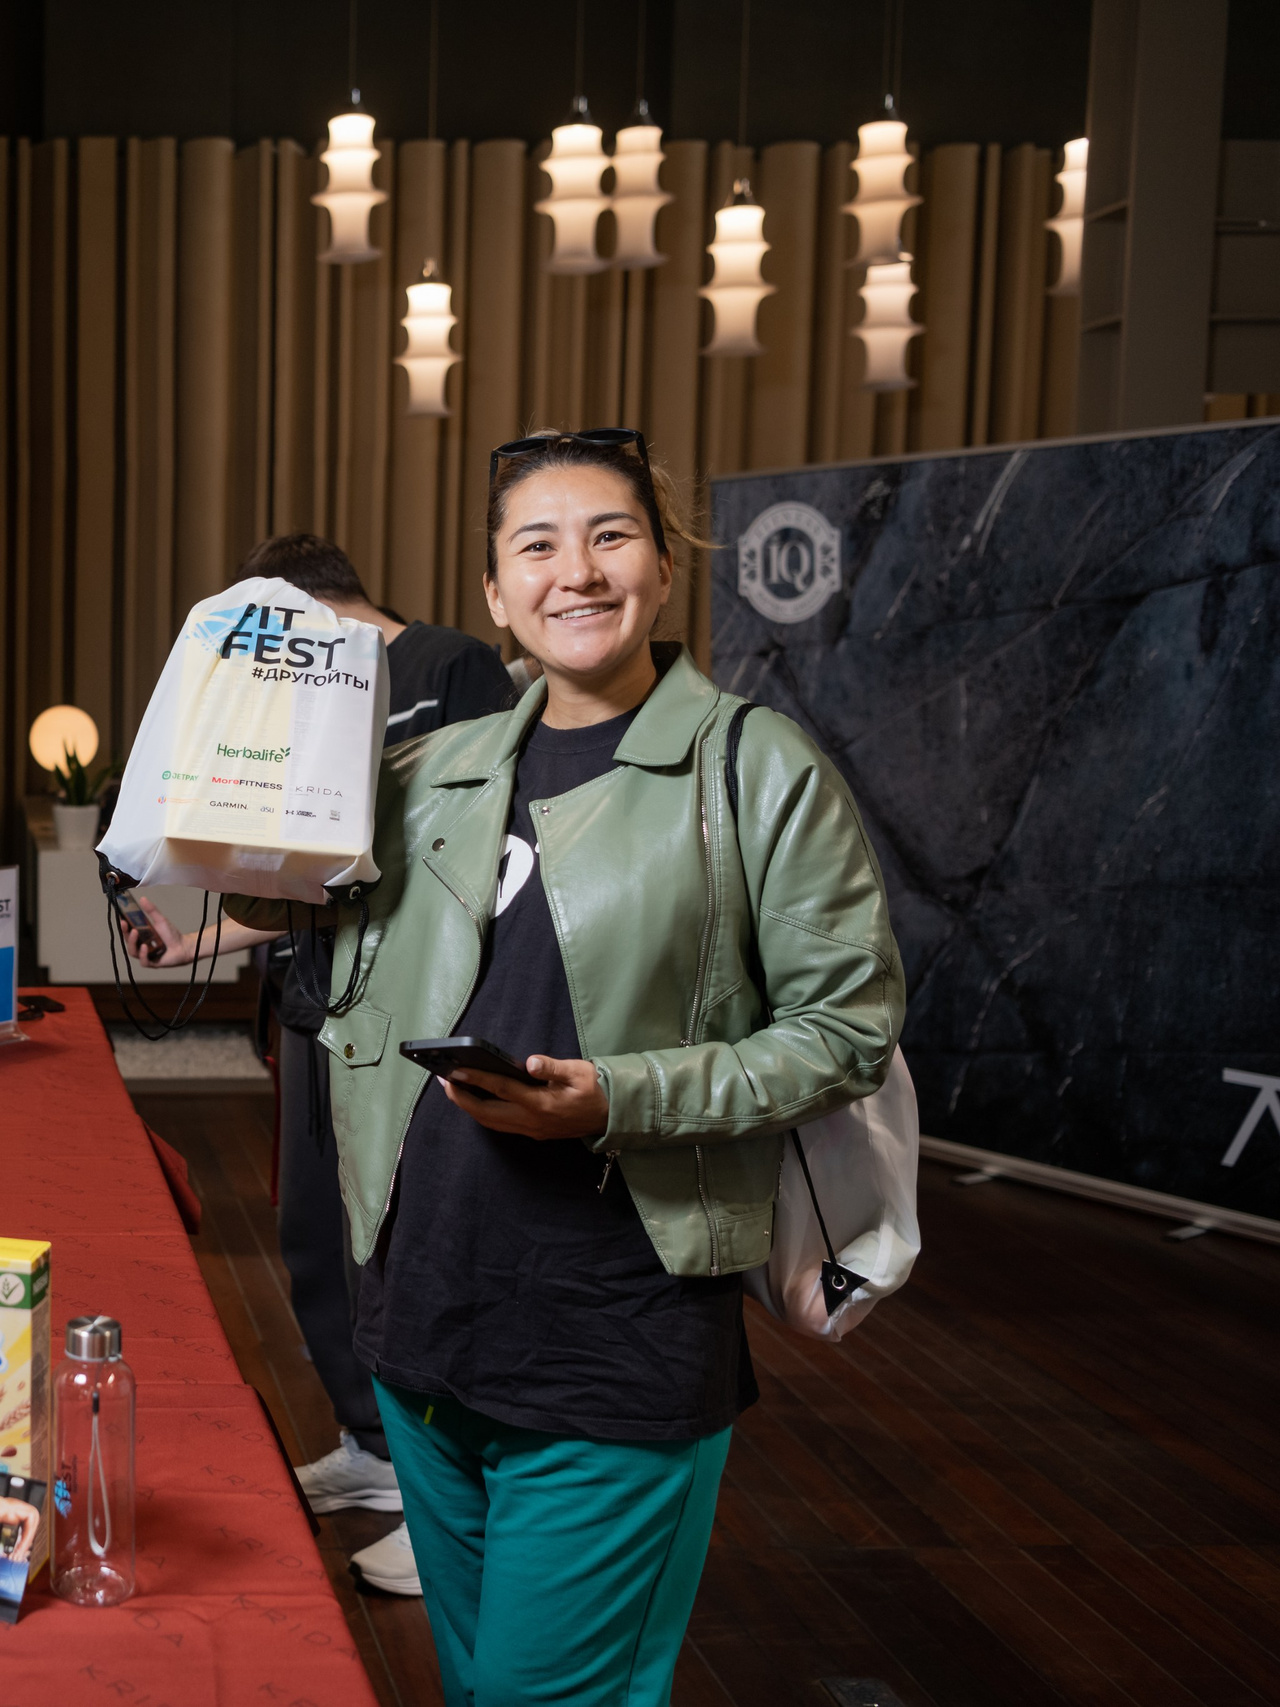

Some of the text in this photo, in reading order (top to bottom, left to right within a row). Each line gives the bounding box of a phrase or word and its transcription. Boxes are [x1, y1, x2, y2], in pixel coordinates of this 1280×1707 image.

[221, 630, 346, 671] FEST
[252, 666, 369, 691] #ДРУГОЙТЫ
[217, 743, 284, 763] Herbalife
[172, 772, 200, 782] JETPAY
[211, 776, 284, 791] MoreFITNESS
[295, 785, 343, 798] KRIDA
